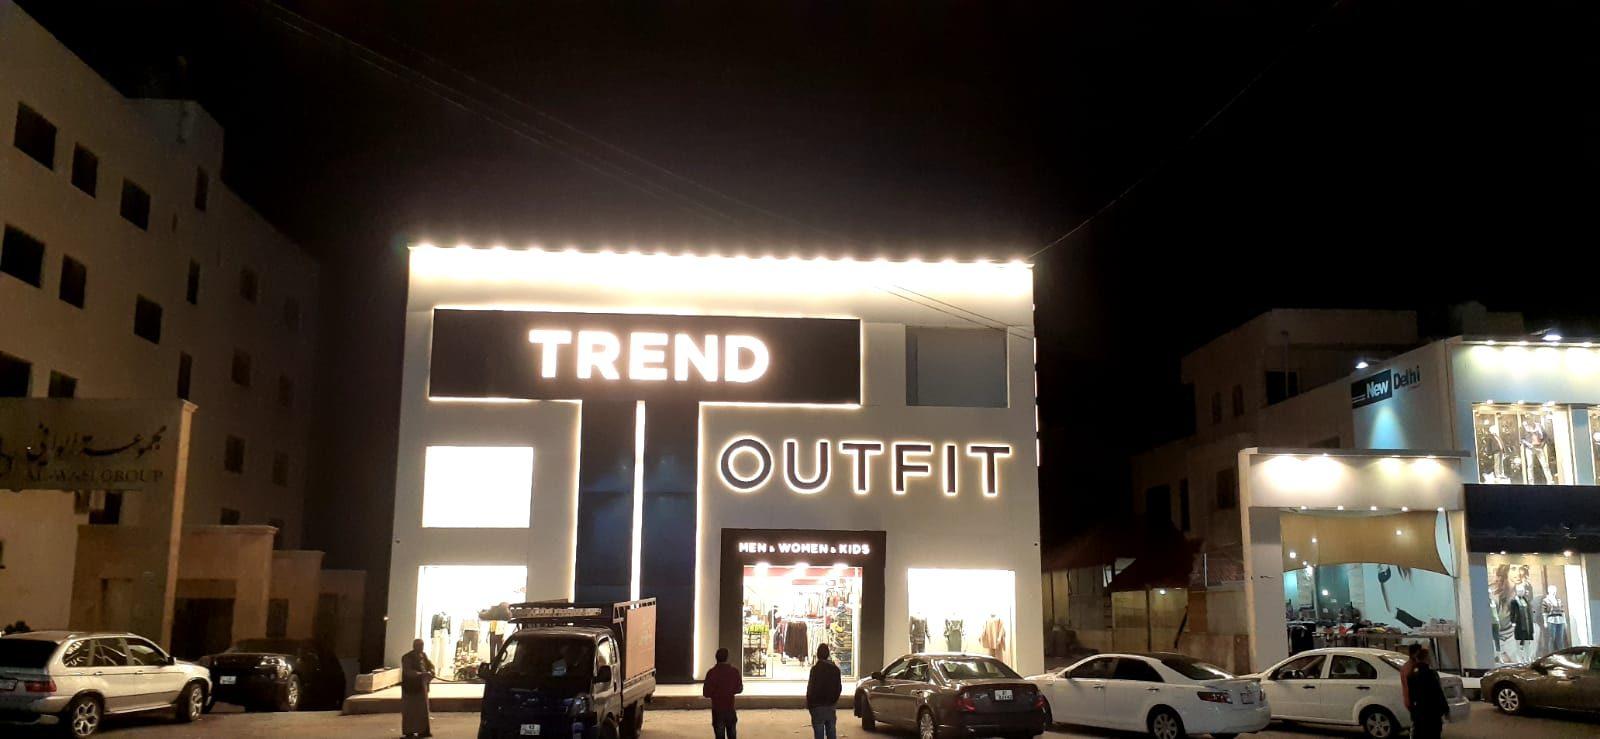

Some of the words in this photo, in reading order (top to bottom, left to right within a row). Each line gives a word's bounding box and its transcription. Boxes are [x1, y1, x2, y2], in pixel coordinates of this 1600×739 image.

[528, 329, 769, 383] TREND
[1366, 380, 1389, 398] New
[1393, 365, 1420, 389] Delhi
[101, 469, 164, 482] GROUP
[719, 437, 1011, 495] OUTFIT
[738, 542, 767, 553] MEN
[769, 545, 775, 553] &
[778, 542, 828, 554] WOMEN
[830, 546, 837, 554] &
[839, 543, 870, 555] KIDS
